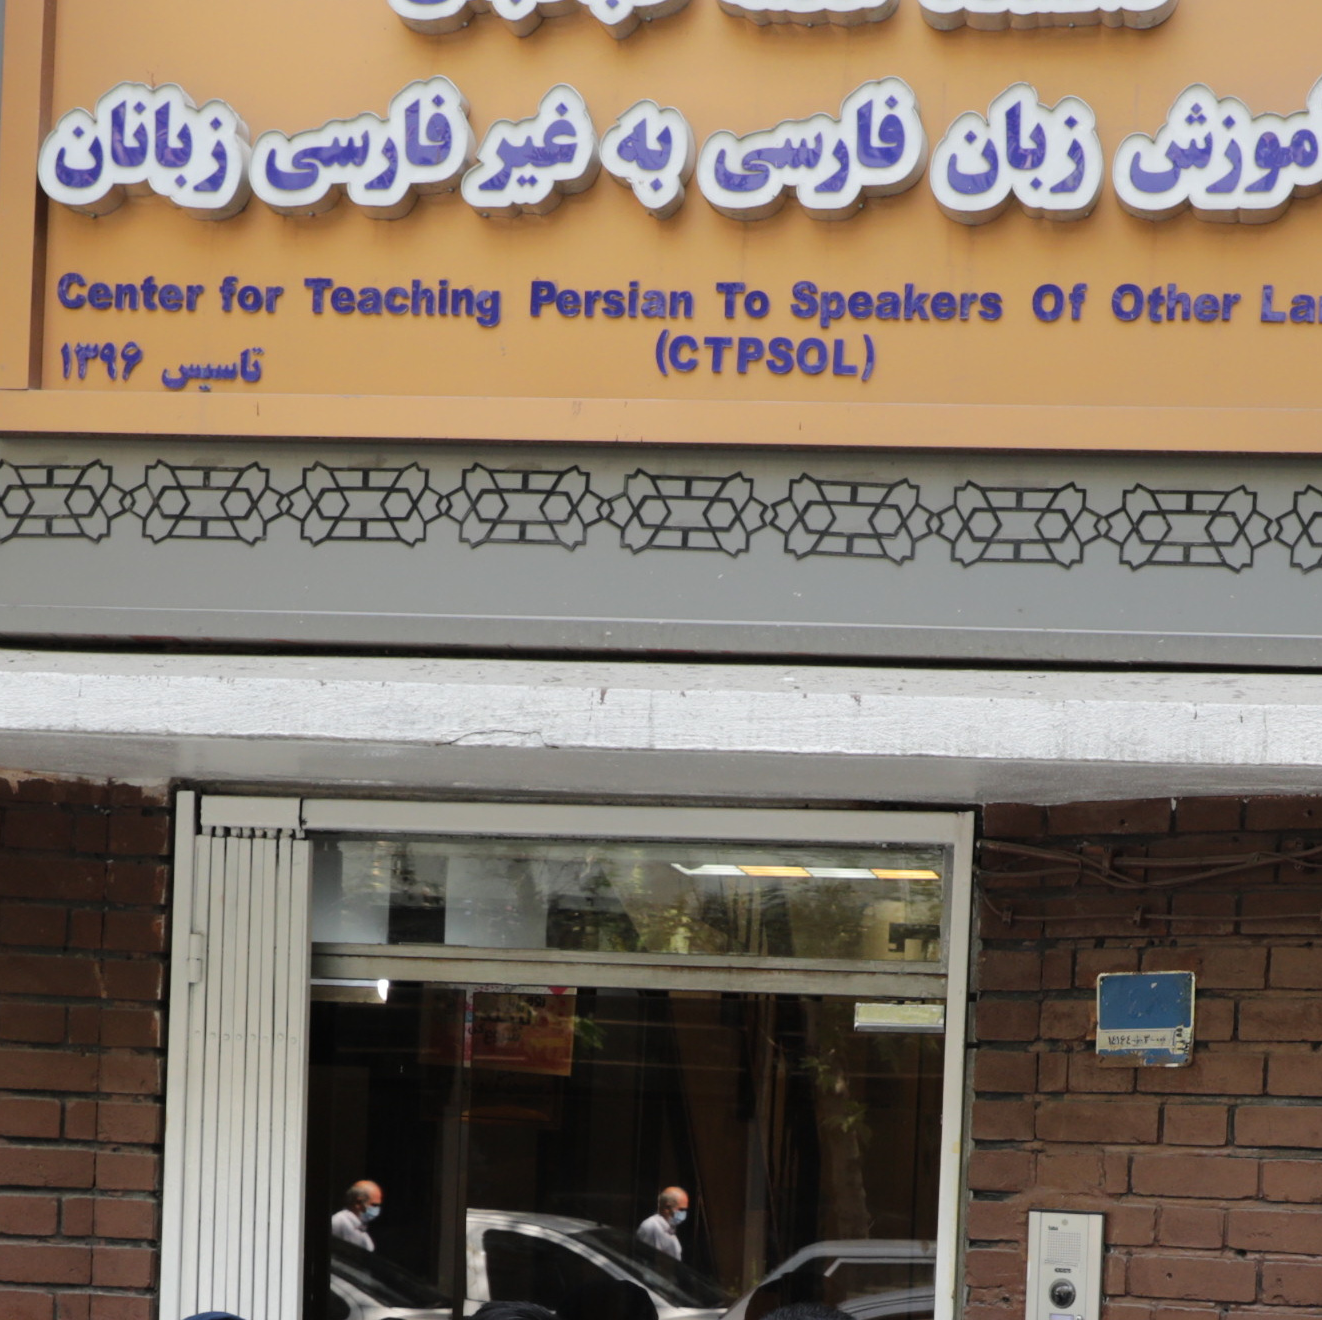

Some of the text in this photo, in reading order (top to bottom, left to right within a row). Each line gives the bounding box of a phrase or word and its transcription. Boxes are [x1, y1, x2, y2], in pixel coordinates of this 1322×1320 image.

[51, 97, 234, 198] زبانان
[261, 90, 458, 197] فارسی
[474, 99, 583, 197] غیر
[613, 116, 679, 197] به
[710, 92, 912, 198] فارسی
[944, 97, 1091, 201] زبان
[57, 273, 204, 312] Center
[219, 276, 283, 313] for
[304, 278, 501, 328] Teaching
[530, 280, 694, 319] Persian
[716, 282, 771, 319] To
[791, 281, 1003, 328] Speakers
[1032, 284, 1088, 322] Of
[1111, 284, 1241, 323] Other
[60, 342, 265, 391] تاسیس ۱۳۹۶
[656, 330, 876, 381] (CTPSOL)
